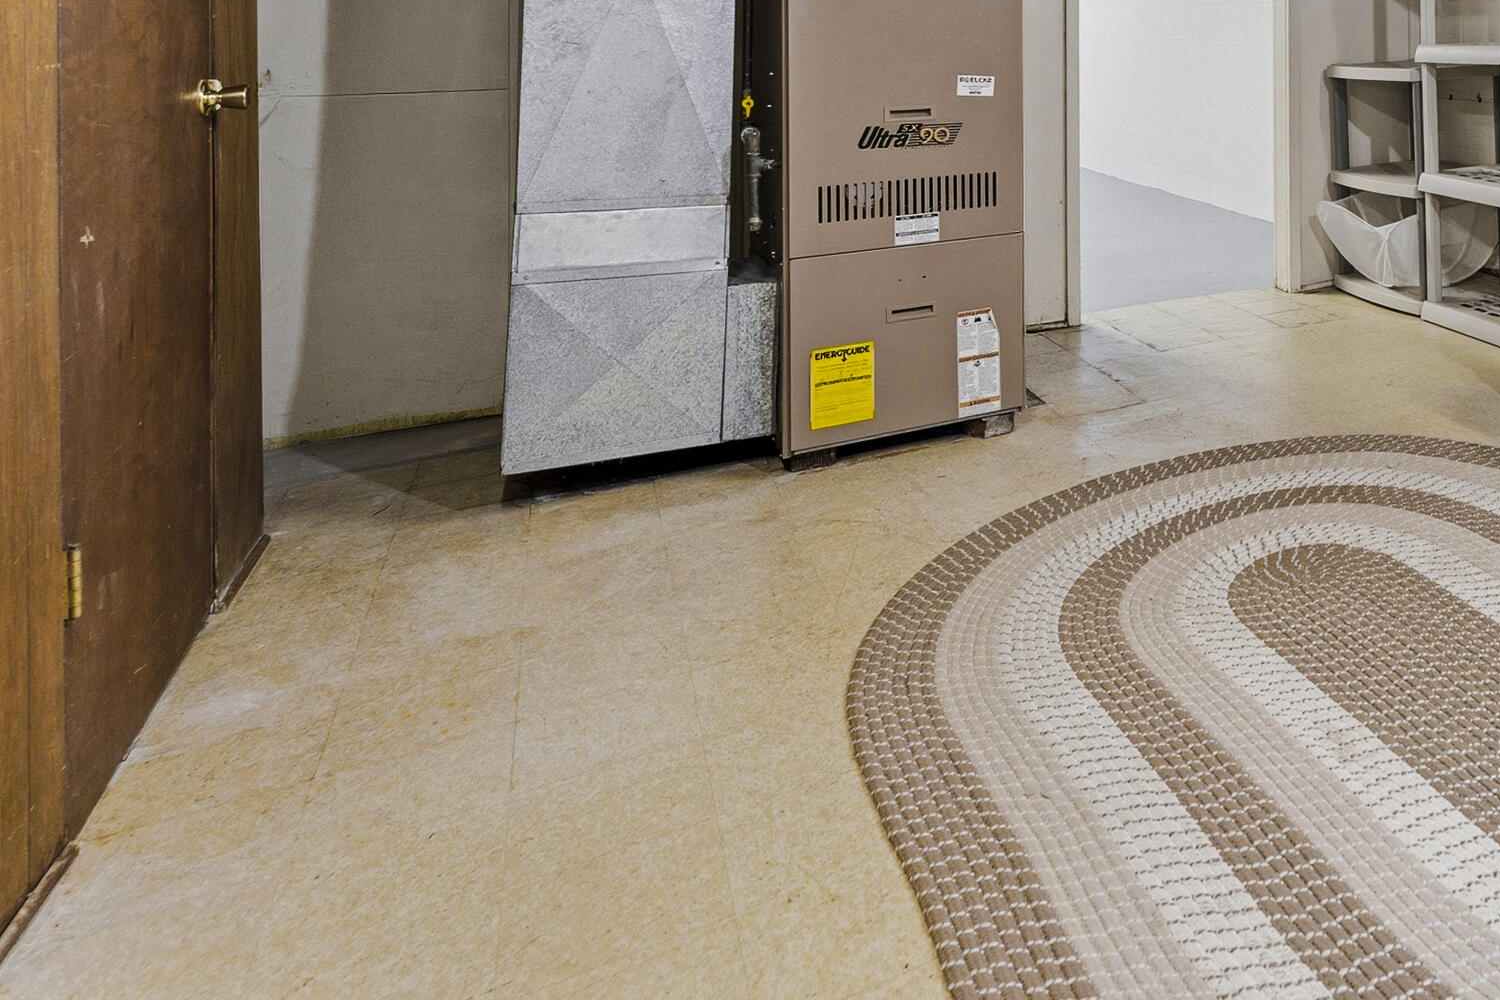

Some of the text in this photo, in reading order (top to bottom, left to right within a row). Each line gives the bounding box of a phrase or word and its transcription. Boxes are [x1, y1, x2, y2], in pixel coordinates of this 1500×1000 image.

[858, 124, 950, 149] Ultra SX 90
